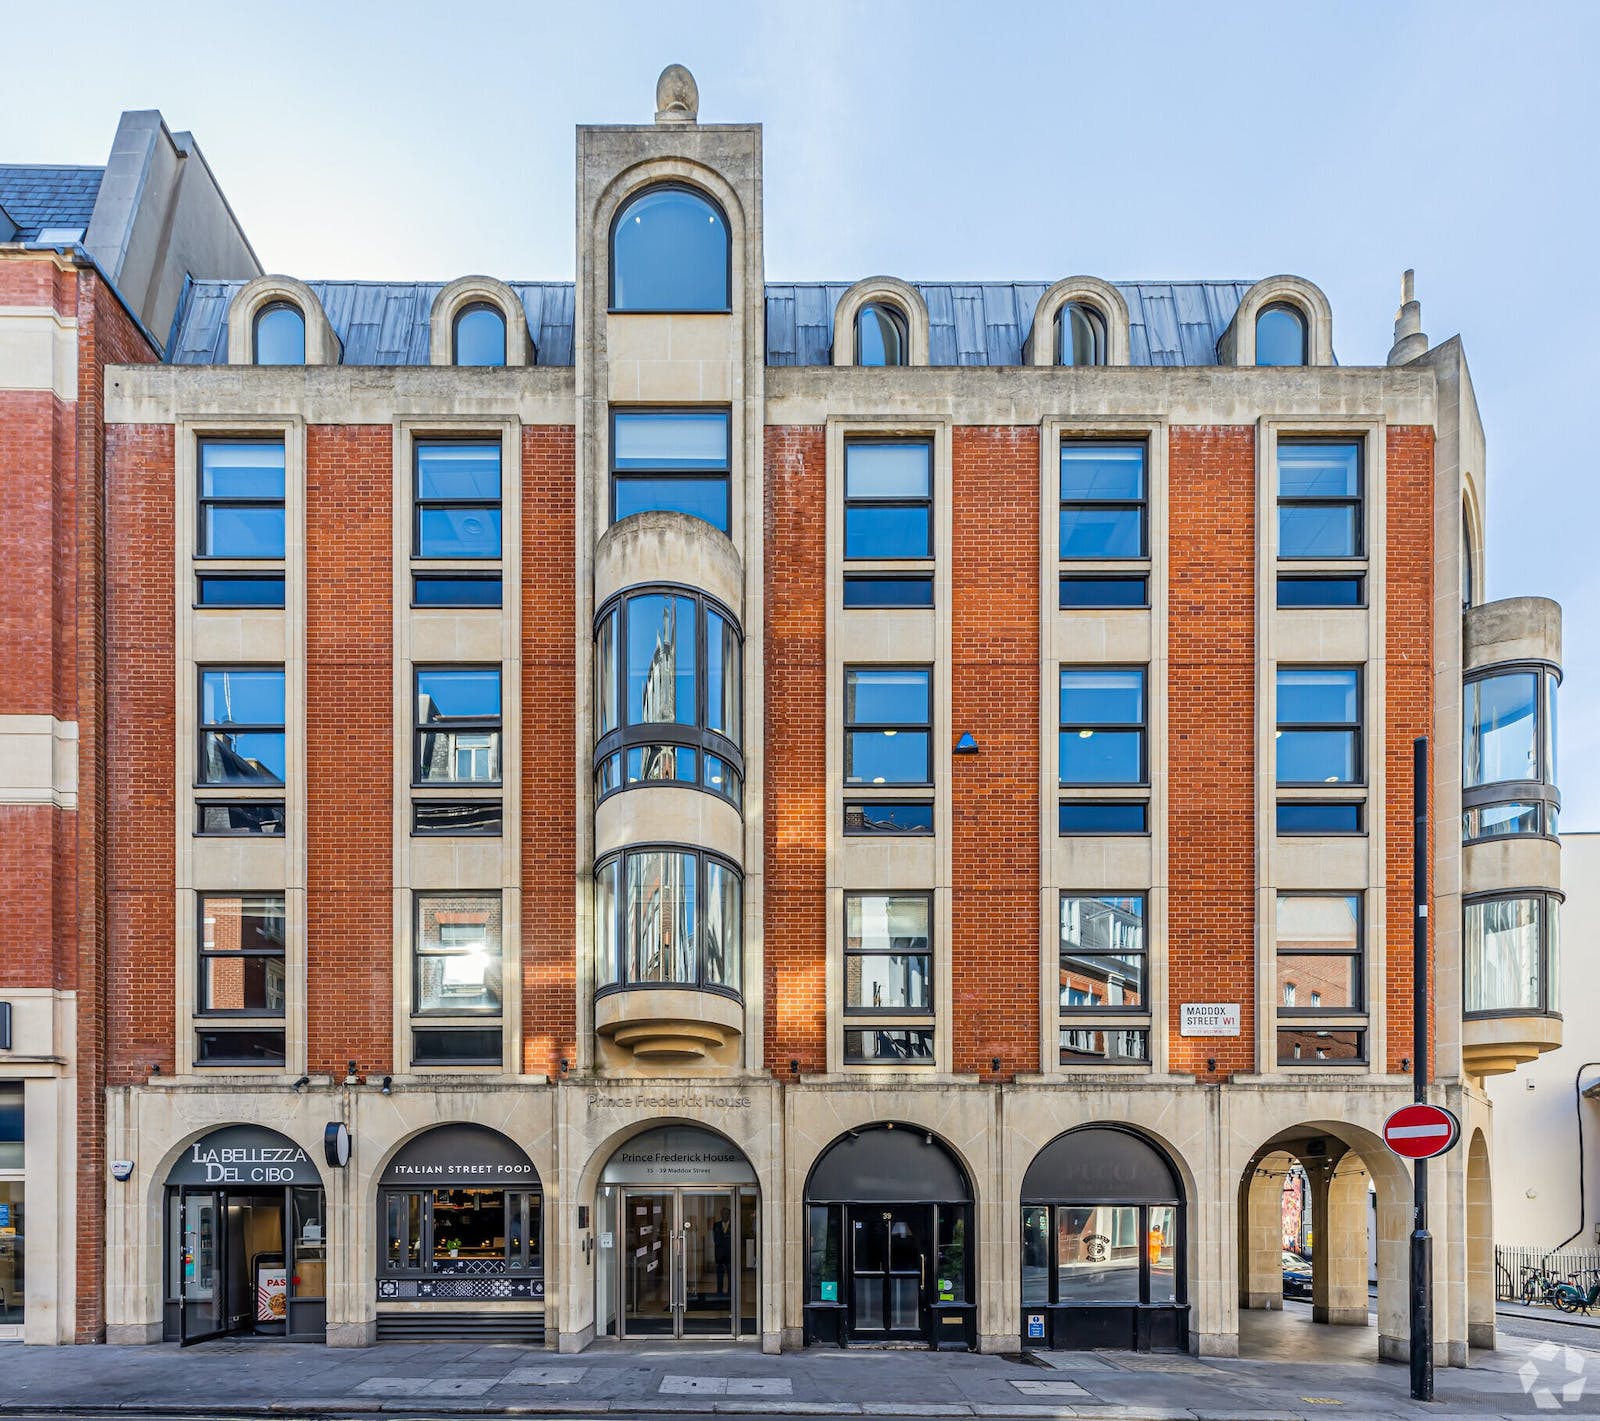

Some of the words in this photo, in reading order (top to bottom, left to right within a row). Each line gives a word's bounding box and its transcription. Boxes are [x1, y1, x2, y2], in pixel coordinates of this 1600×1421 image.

[1186, 1007, 1226, 1016] MADDOX
[1187, 1016, 1219, 1025] STREET
[1222, 1017, 1235, 1025] W1
[587, 1094, 633, 1108] Prince
[635, 1094, 702, 1108] Frederick
[704, 1095, 752, 1108] House
[622, 1153, 653, 1162] Prince
[655, 1152, 701, 1162] Frederick
[703, 1153, 735, 1162] House
[205, 1162, 245, 1182] DEL
[250, 1167, 294, 1182] CIBO
[395, 1165, 443, 1174] ITALIAN
[448, 1165, 493, 1174] STREET
[497, 1165, 531, 1174] FOOD
